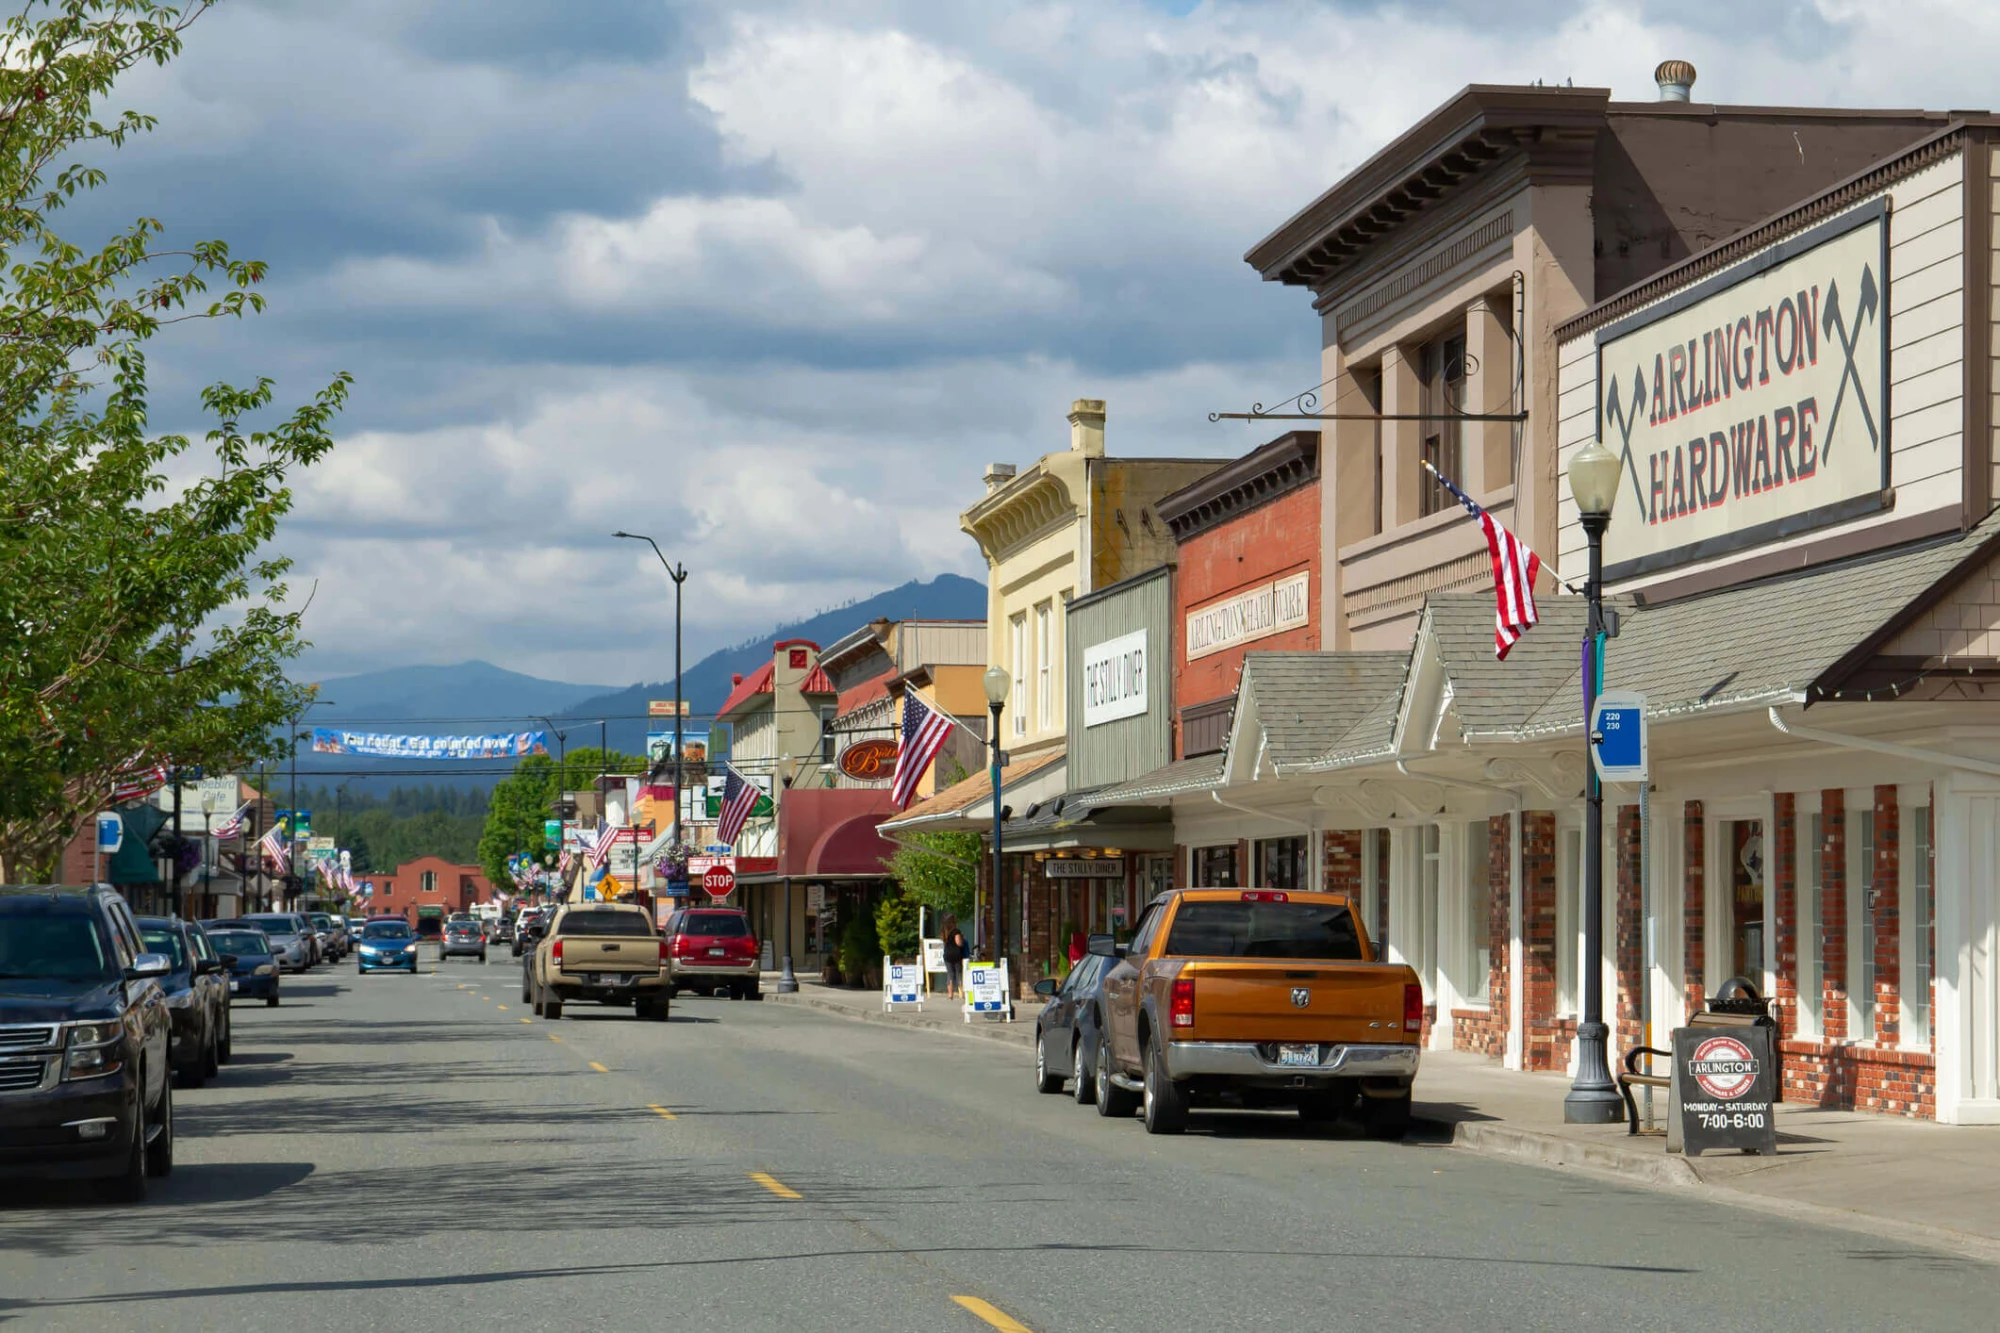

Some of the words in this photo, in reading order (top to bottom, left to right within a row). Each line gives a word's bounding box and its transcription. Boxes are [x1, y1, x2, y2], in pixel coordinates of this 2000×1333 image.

[1650, 284, 1819, 427] ARLINGTON
[1650, 396, 1819, 526] HARDWARE
[1189, 603, 1241, 652] ARLINGTON
[1246, 582, 1304, 633] HARDWARE
[1086, 663, 1099, 709] THE
[1605, 712, 1620, 721] 220
[1606, 722, 1620, 730] 230
[1053, 863, 1066, 873] THE
[1069, 863, 1093, 873] STILLY
[1095, 863, 1116, 873] DINER
[705, 874, 733, 887] STOP
[892, 967, 901, 978] 10
[974, 972, 984, 983] 10
[1695, 1062, 1751, 1073] ARLINGTON
